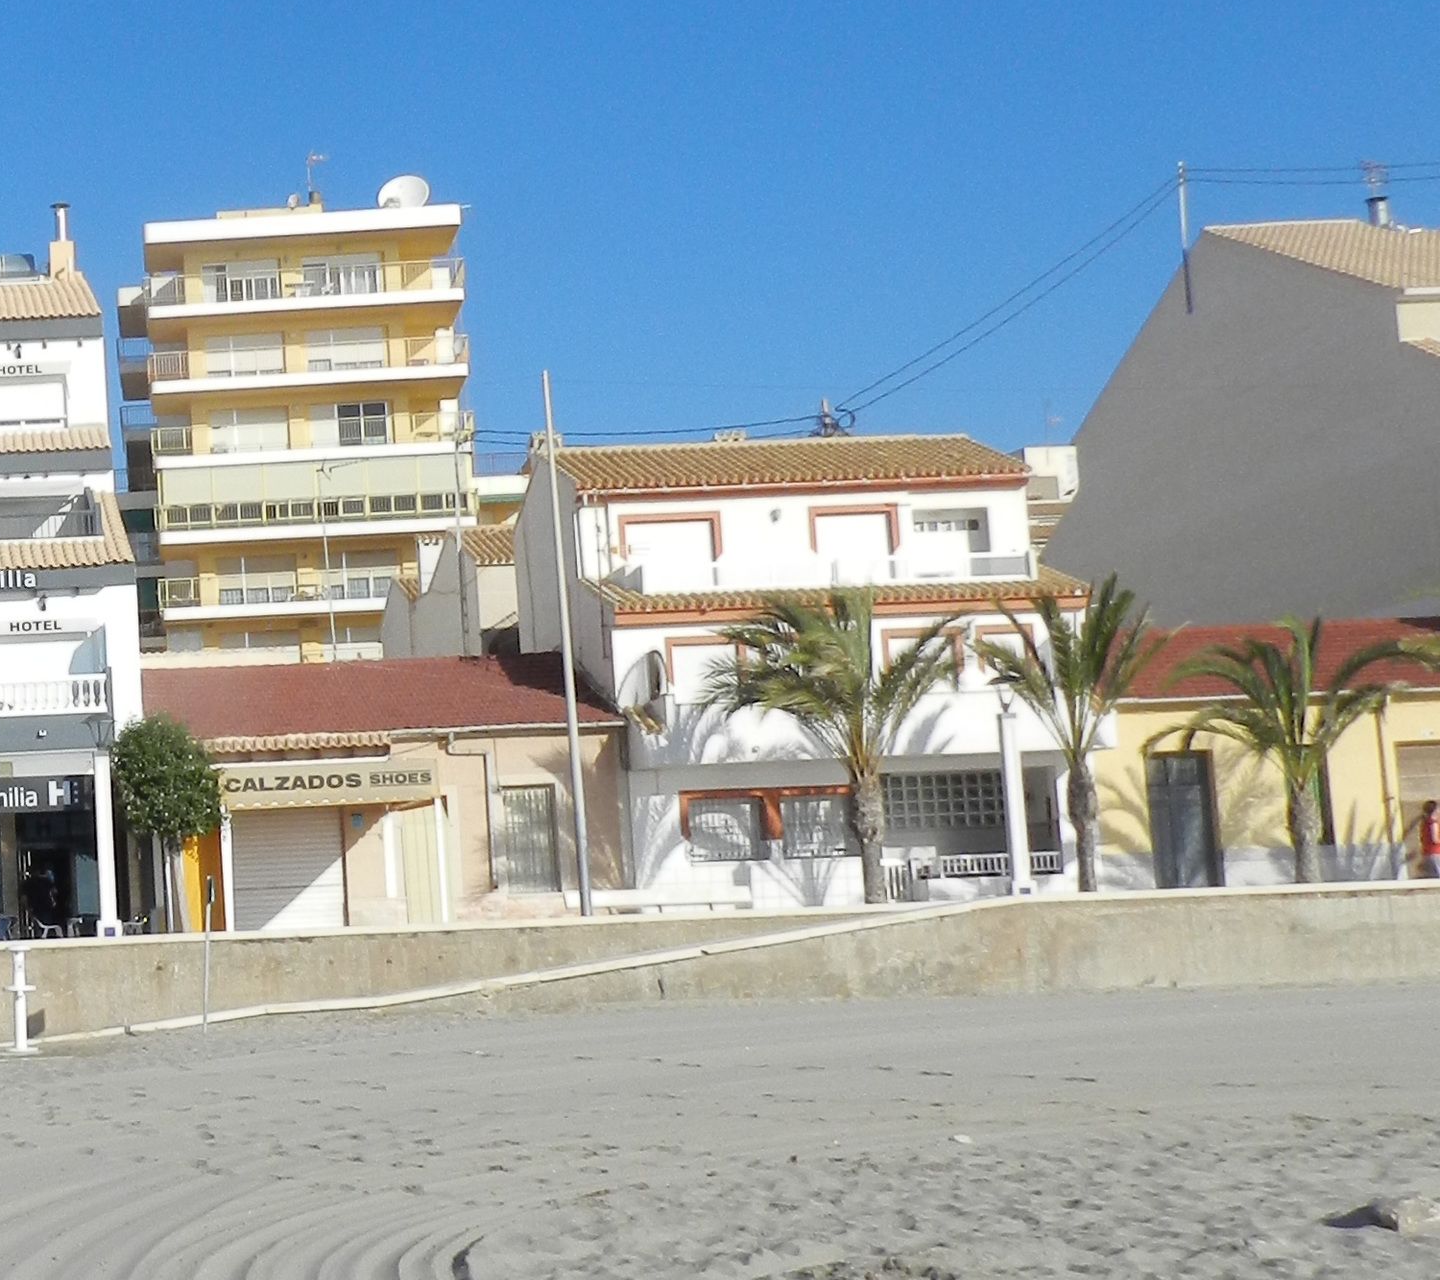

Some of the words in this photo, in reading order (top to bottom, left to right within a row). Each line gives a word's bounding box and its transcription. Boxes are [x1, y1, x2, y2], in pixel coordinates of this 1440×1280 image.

[9, 620, 62, 632] HOTEL
[224, 773, 362, 793] CALZADOS
[369, 771, 432, 785] SHOES
